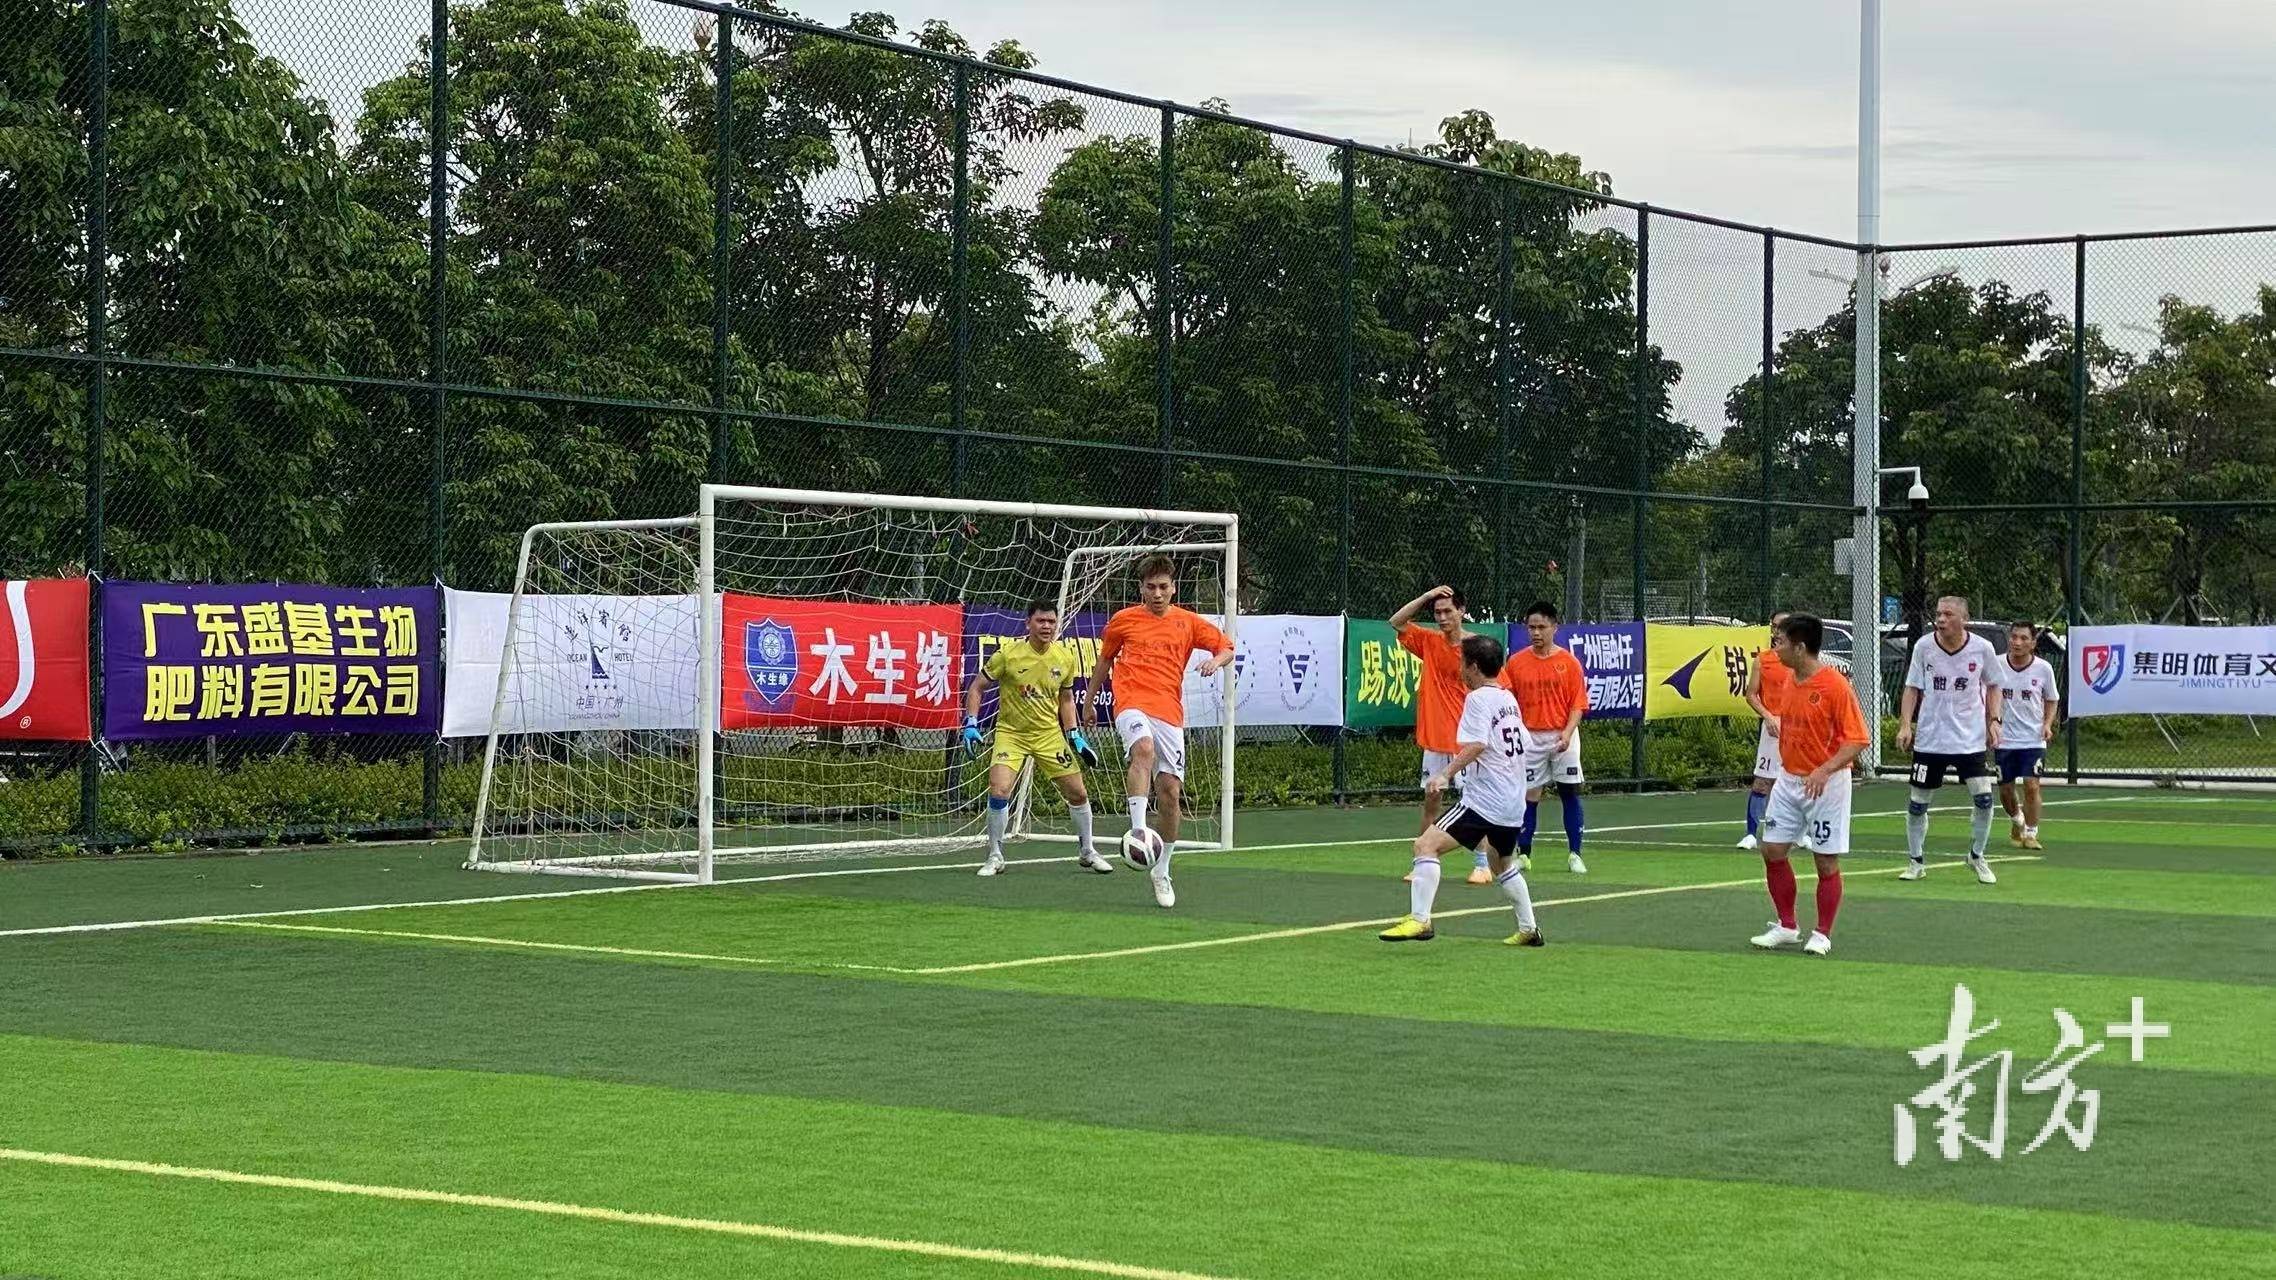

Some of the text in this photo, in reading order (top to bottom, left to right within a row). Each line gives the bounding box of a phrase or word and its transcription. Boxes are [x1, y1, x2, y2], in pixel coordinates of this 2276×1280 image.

[141, 601, 418, 658] 广东盛基生物
[614, 653, 633, 662] HOTEL
[809, 627, 952, 706] 木生缘
[1724, 645, 1760, 697] 锐
[143, 664, 420, 721] 肥料有限公司
[756, 671, 788, 686] 木生缘
[1583, 673, 1644, 711] 有限公司
[1056, 749, 1072, 765] 66
[1502, 727, 1524, 757] 53
[1759, 757, 1771, 771] 21
[1813, 820, 1831, 839] 25
